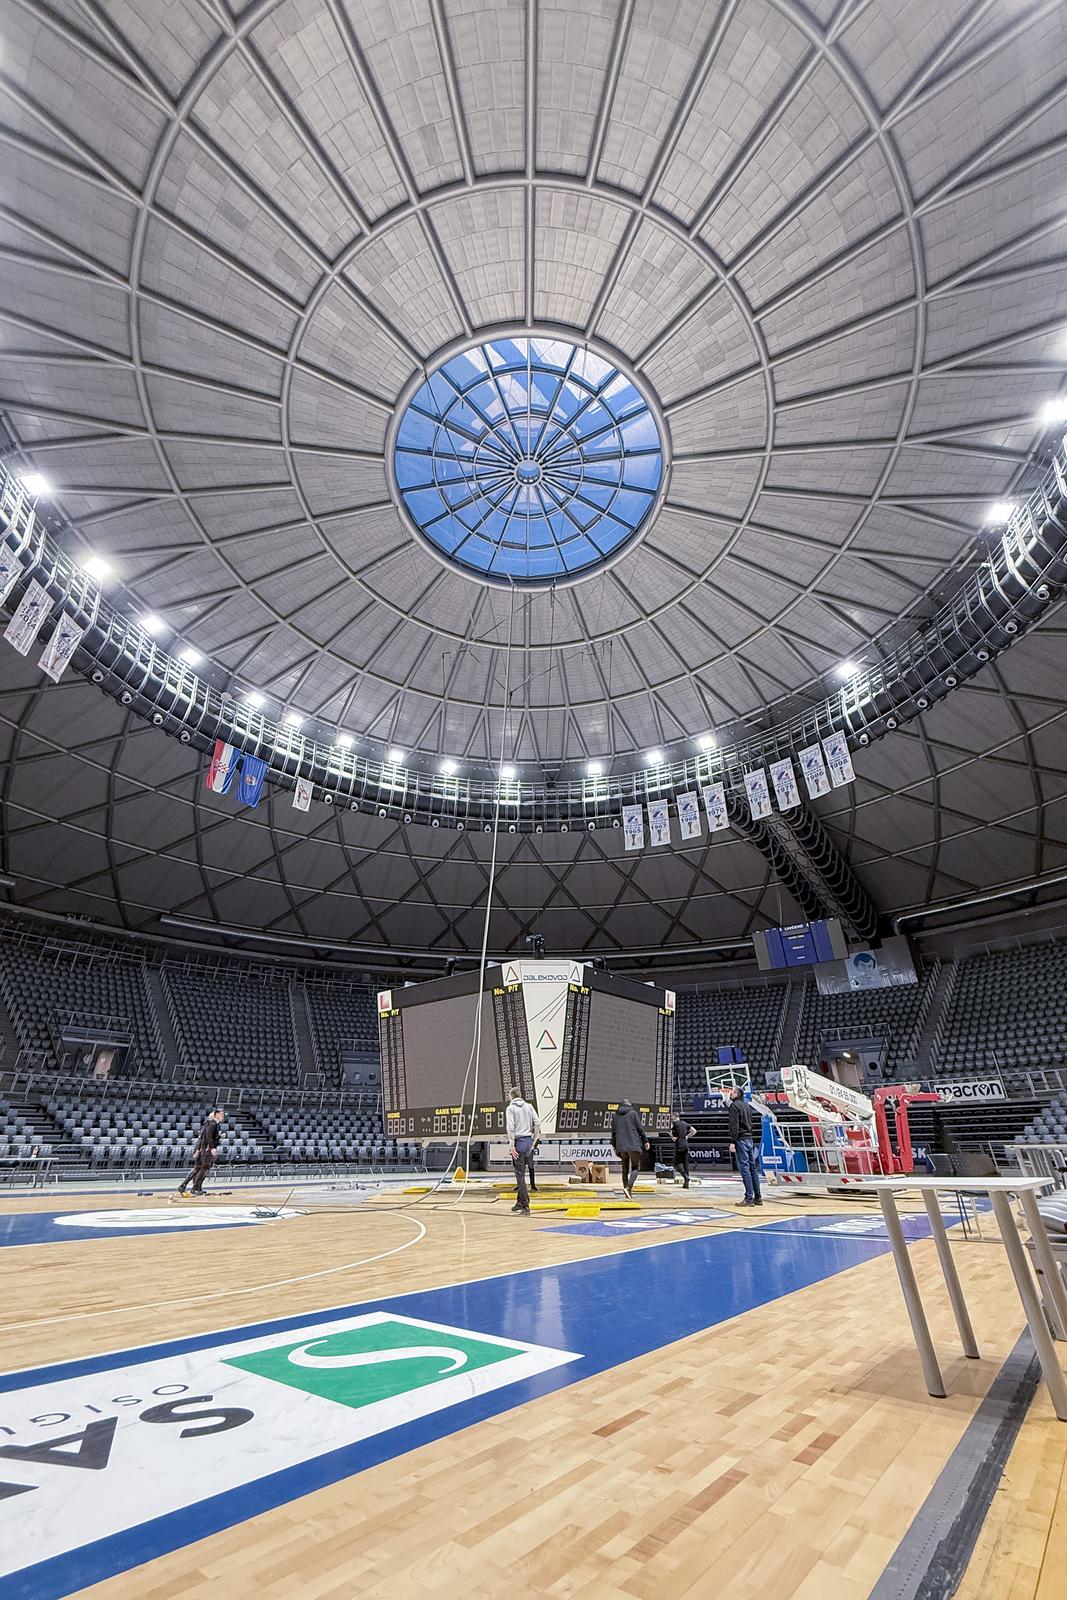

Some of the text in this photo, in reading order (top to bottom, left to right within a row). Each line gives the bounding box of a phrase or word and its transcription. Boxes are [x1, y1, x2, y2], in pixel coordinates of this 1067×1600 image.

[830, 758, 848, 770] 1998
[776, 784, 794, 794] 1975
[750, 794, 768, 804] 1974
[708, 807, 725, 817] 1970
[625, 827, 641, 835] 1965
[651, 822, 667, 831] 1967
[507, 984, 519, 993] P/T
[935, 1083, 1002, 1098] macron
[703, 1099, 725, 1109] PSK
[561, 1148, 613, 1158] SUPERNOVA
